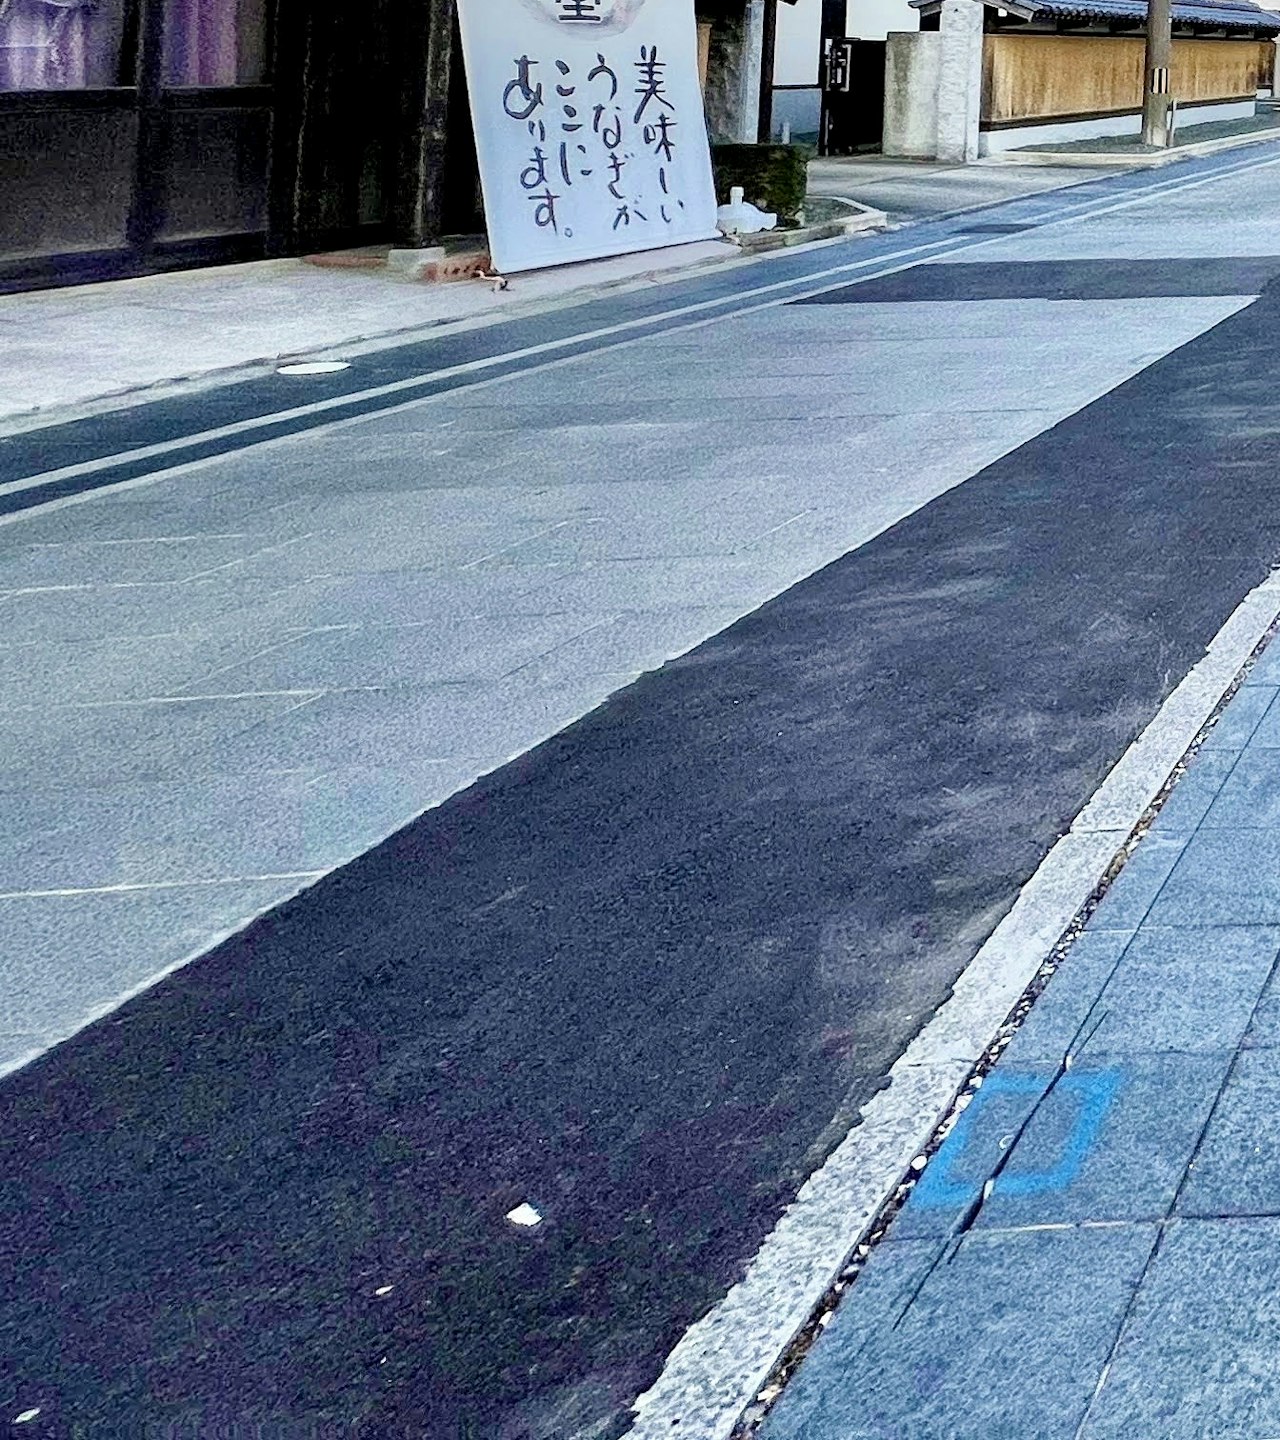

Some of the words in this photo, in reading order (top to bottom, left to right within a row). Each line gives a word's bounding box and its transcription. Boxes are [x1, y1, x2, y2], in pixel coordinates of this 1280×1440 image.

[503, 54, 573, 238] あります。
[555, 60, 592, 186] ここに
[588, 52, 648, 230] うなぎが
